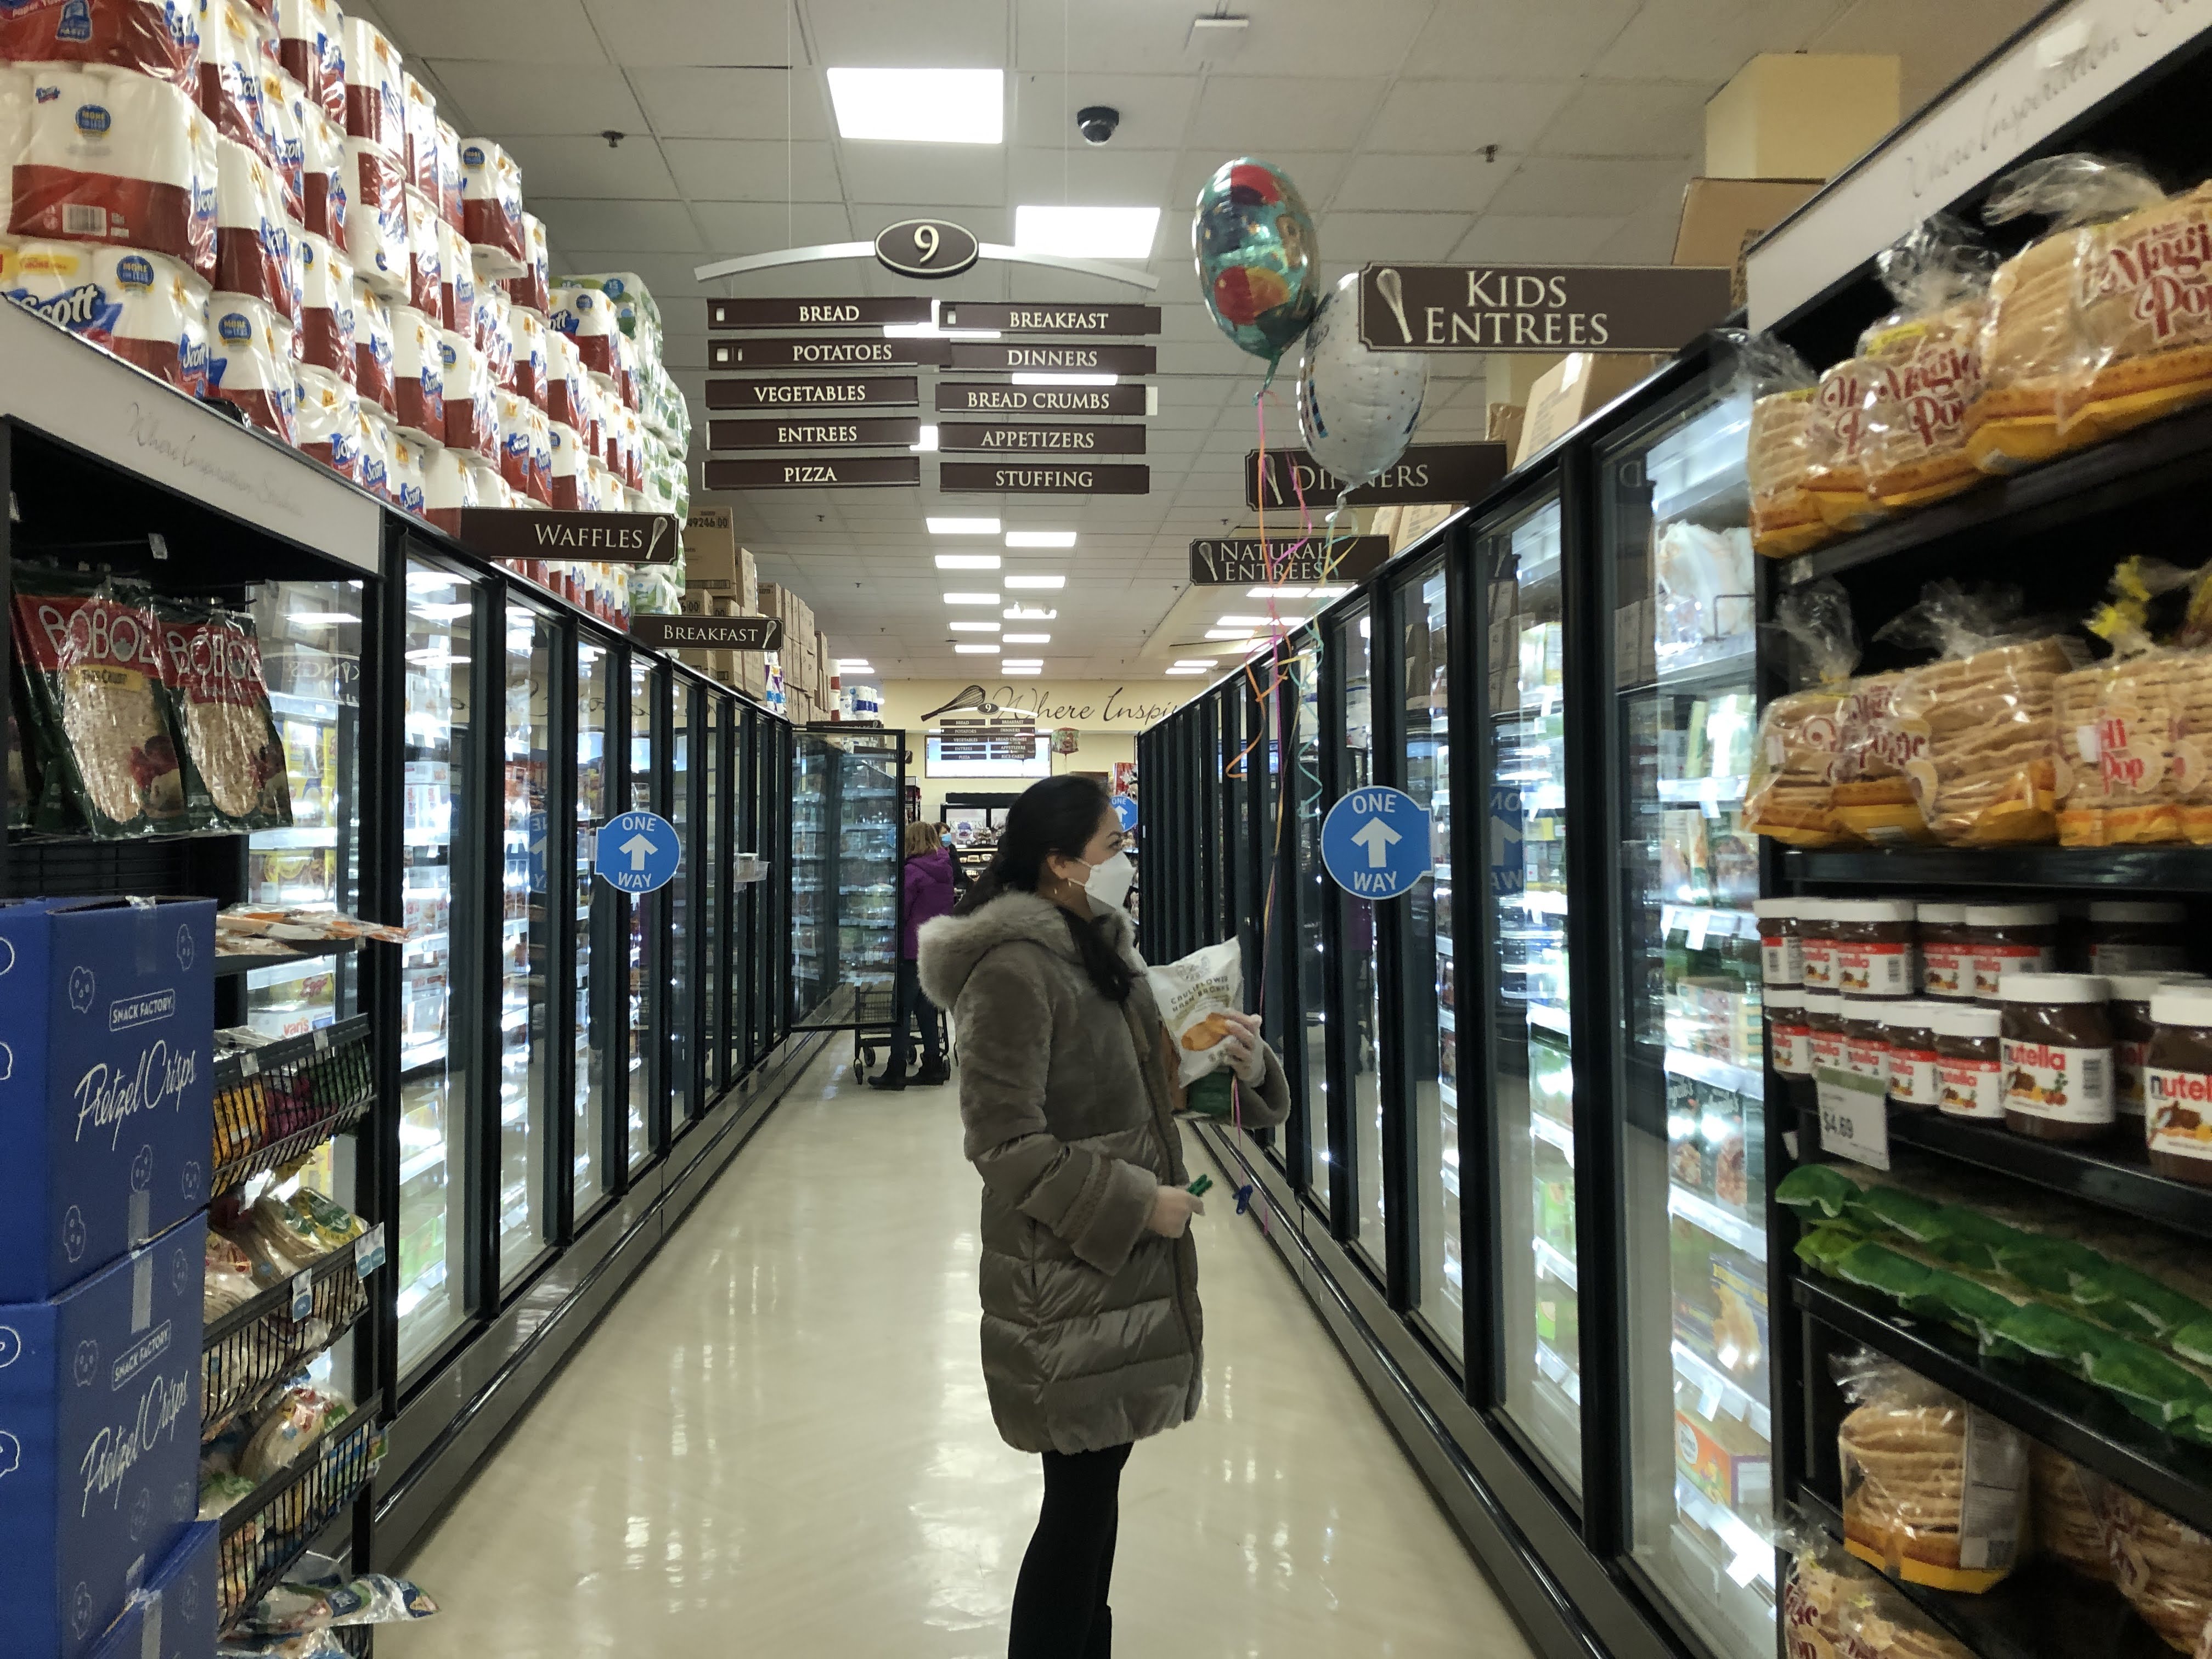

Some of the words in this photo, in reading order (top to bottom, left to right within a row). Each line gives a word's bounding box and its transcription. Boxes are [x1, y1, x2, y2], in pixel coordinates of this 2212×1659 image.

[915, 225, 939, 263] 9
[1466, 270, 1567, 308] KIDS
[799, 306, 860, 321] BREAD
[1009, 312, 1109, 329] BREAKFAST
[1424, 306, 1610, 345] ENTREES
[793, 344, 893, 362] POTATOES
[1007, 349, 1098, 367] DINNERS
[753, 385, 866, 402] VEGETABLES
[967, 392, 1028, 408] BREAD
[1032, 393, 1110, 409] CRUMBS
[777, 426, 857, 443] ENTREES
[980, 431, 1095, 449] APPETIZERS
[783, 467, 838, 482] PIZZA
[995, 470, 1093, 487] STUFFING
[1293, 464, 1429, 492] DIERS
[534, 523, 643, 549] WAFFLES
[1220, 541, 1328, 561] NATURAL
[1225, 561, 1323, 582] ENTREES
[38, 605, 156, 664] BOBOL
[663, 624, 759, 642] BREAKFAST
[166, 630, 259, 682] BOBOL
[985, 703, 992, 712] 9
[992, 686, 1095, 720] Where
[1352, 793, 1397, 814] ONE
[622, 815, 657, 832] ONE
[618, 871, 652, 888] WAY
[1353, 871, 1397, 893] WAY
[112, 1004, 138, 1024] SNACK
[140, 996, 173, 1017] FACTORY
[2002, 1043, 2067, 1071] nutella
[74, 1048, 146, 1152] Pretzel
[144, 1039, 197, 1113] Crisps
[2150, 1074, 2212, 1103] nutel
